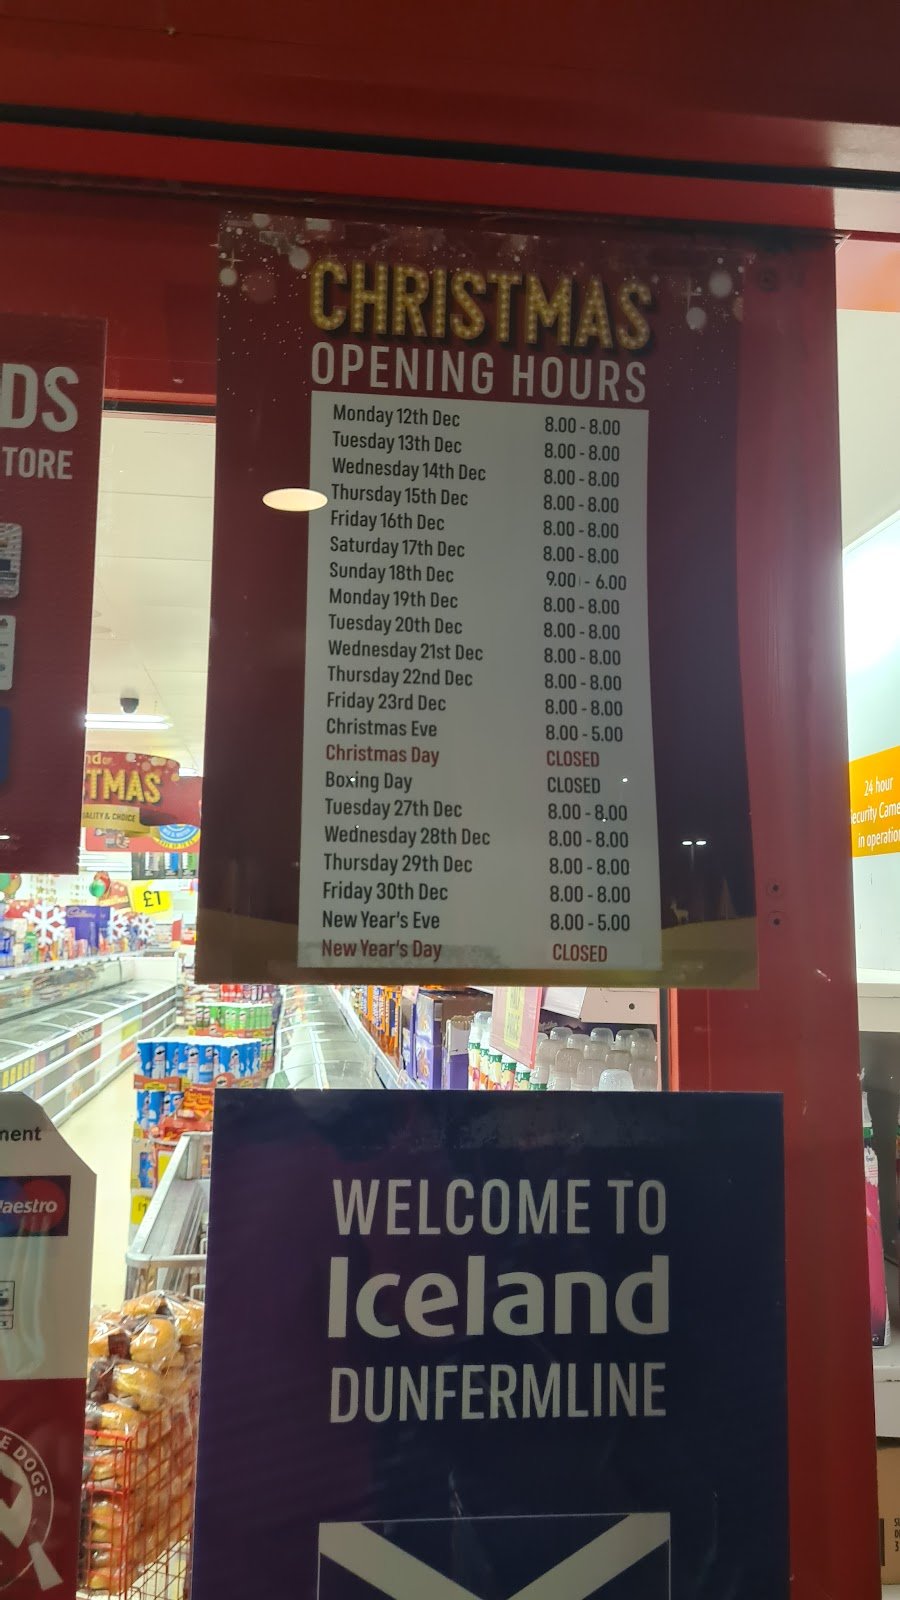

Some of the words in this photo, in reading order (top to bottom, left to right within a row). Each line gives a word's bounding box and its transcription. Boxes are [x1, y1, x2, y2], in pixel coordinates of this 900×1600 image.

[310, 261, 653, 351] CHRISTMAS
[311, 342, 494, 395] OPENING
[513, 355, 646, 403] HOURS
[333, 404, 393, 427] Monday
[397, 408, 428, 425] 12th
[433, 410, 460, 427] Dec
[545, 417, 576, 433] 8.00
[589, 419, 620, 435] 8.00
[333, 431, 394, 454] Tuesday
[398, 435, 430, 451] 13th
[435, 437, 462, 453] Dec
[545, 443, 575, 459] 8.00
[589, 445, 619, 461] 8.00
[2, 446, 73, 480] TORE
[332, 458, 419, 481] Wednesday
[423, 463, 454, 479] 14th
[459, 464, 486, 481] Dec
[544, 469, 575, 485] 8.00
[588, 471, 619, 487] 8.00
[332, 484, 401, 506] Thursday
[405, 488, 436, 504] 15th
[441, 490, 468, 506] Dec
[544, 495, 574, 511] 8.00
[588, 497, 618, 513] 8.00
[331, 510, 377, 531] Friday
[381, 513, 412, 529] 16th
[417, 515, 444, 530] Dec
[544, 521, 574, 536] 8.00
[588, 523, 618, 538] 8.00
[330, 536, 399, 558] Saturday
[402, 540, 432, 556] 17th
[438, 541, 465, 557] Dec
[544, 546, 574, 562] 8.00
[588, 548, 618, 564] 8.00
[330, 562, 386, 583] Sunday
[389, 565, 422, 581] 18th
[427, 566, 454, 582] Dec
[546, 571, 575, 587] 9.00
[596, 575, 626, 590] 6.00
[329, 588, 390, 609] Monday
[393, 591, 426, 607] 19th
[431, 592, 458, 608] Dec
[544, 597, 575, 613] 8.00
[588, 599, 619, 615] 8.00
[329, 614, 392, 635] Tuesday
[395, 617, 430, 632] 20th
[435, 618, 462, 634] Dec
[544, 623, 575, 638] 8.00
[589, 624, 620, 640] 8.00
[329, 640, 417, 662] Wednesday
[421, 643, 451, 659] 21st
[456, 645, 483, 660] Dec
[544, 648, 576, 663] 8.00
[590, 650, 621, 665] 8.00
[328, 666, 399, 688] Thursday
[403, 669, 440, 685] 22nd
[445, 670, 473, 686] Dec
[545, 674, 576, 689] 8.00
[590, 675, 621, 691] 8.00
[327, 692, 374, 713] Friday
[378, 694, 413, 710] 23rd
[418, 695, 446, 711] Dec
[545, 699, 577, 715] 8.00
[591, 701, 622, 716] 8.00
[326, 718, 407, 736] Christmas
[412, 721, 437, 736] Eve
[546, 725, 578, 741] 8.00
[592, 726, 623, 742] 5.00
[326, 744, 407, 762] Christmas
[412, 747, 439, 767] Day
[547, 751, 599, 767] CLOSED
[326, 771, 379, 793] Boxing
[384, 773, 412, 793] Day
[548, 777, 600, 793] CLOSED
[864, 780, 874, 796] 24
[876, 776, 893, 793] hour
[325, 798, 390, 820] Tuesday
[394, 800, 428, 816] 27th
[434, 801, 462, 817] Dec
[548, 804, 581, 820] 8.00
[595, 805, 627, 821] 8.00
[325, 825, 416, 848] Wednesday
[421, 828, 457, 844] 28th
[462, 828, 490, 845] Dec
[549, 831, 581, 847] 8.00
[596, 832, 628, 848] 8.00
[858, 833, 865, 848] in
[324, 853, 398, 876] Thursday
[402, 855, 438, 872] 29th
[444, 856, 472, 872] Dec
[550, 858, 582, 874] 8.00
[597, 859, 629, 875] 8.00
[143, 890, 161, 908] £1
[323, 881, 372, 904] Friday
[377, 882, 414, 900] 30th
[419, 884, 448, 900] Dec
[550, 886, 583, 902] 8.00
[598, 887, 630, 903] 8.00
[322, 911, 357, 928] New
[413, 912, 440, 928] Eve
[551, 914, 583, 931] 8.00
[598, 914, 630, 931] 5.00
[322, 940, 357, 957] New
[413, 940, 442, 962] Day
[553, 943, 607, 962] CLOSED
[0, 1199, 58, 1214] aestro
[332, 1178, 591, 1236] WELCOME
[607, 1179, 666, 1236] TO
[328, 1254, 669, 1339] Iceland
[330, 1362, 666, 1423] DUNFERMLINE
[13, 1446, 48, 1497] DOGS
